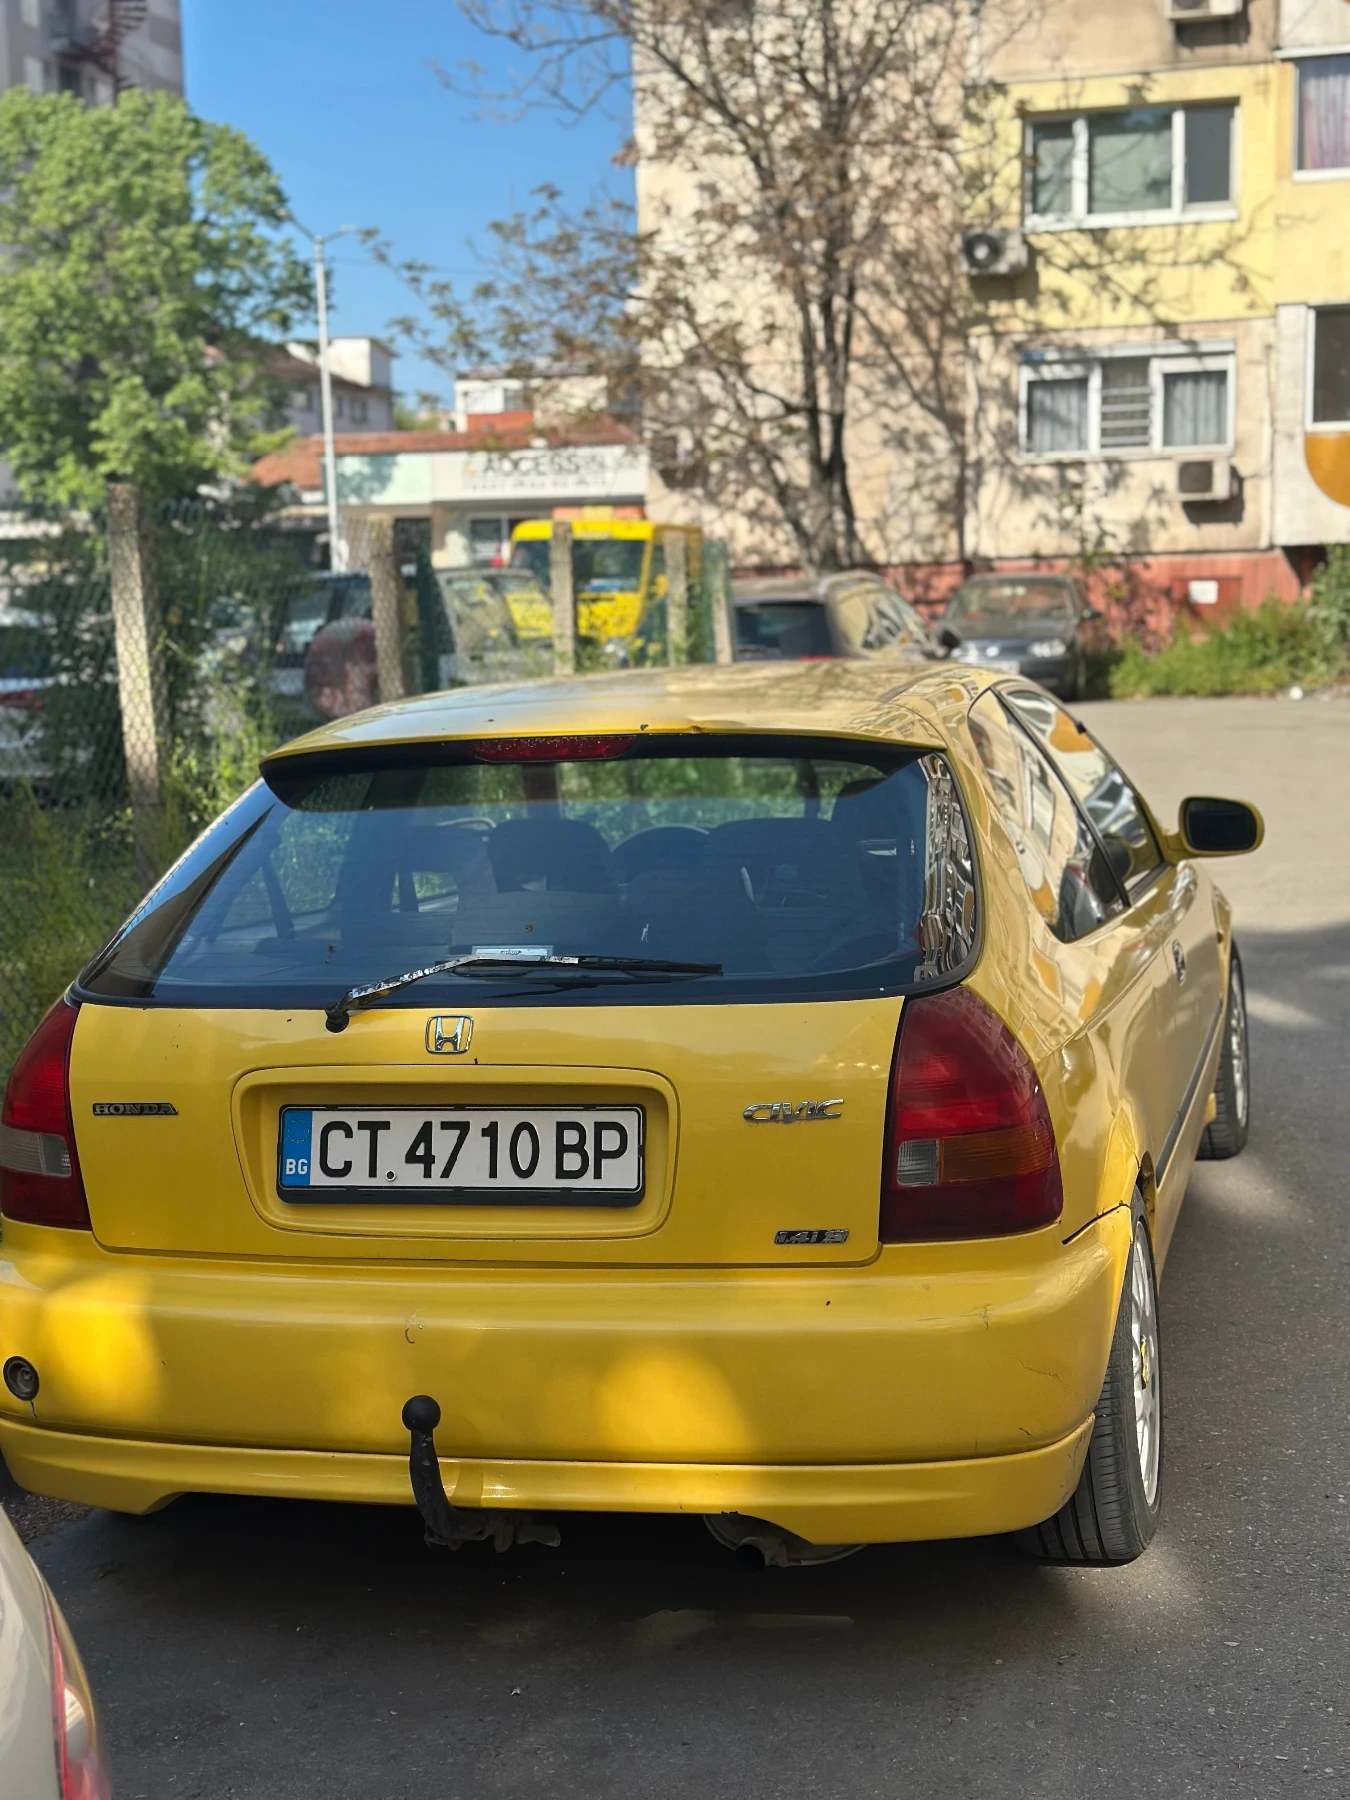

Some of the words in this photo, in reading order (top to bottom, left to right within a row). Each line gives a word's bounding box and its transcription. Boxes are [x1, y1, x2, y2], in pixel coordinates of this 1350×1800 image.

[94, 1103, 177, 1115] HONDA
[743, 1098, 844, 1124] CIVIC
[319, 1120, 391, 1179] CT
[404, 1120, 540, 1180] 4710
[555, 1120, 629, 1181] BP
[285, 1158, 308, 1175] BG
